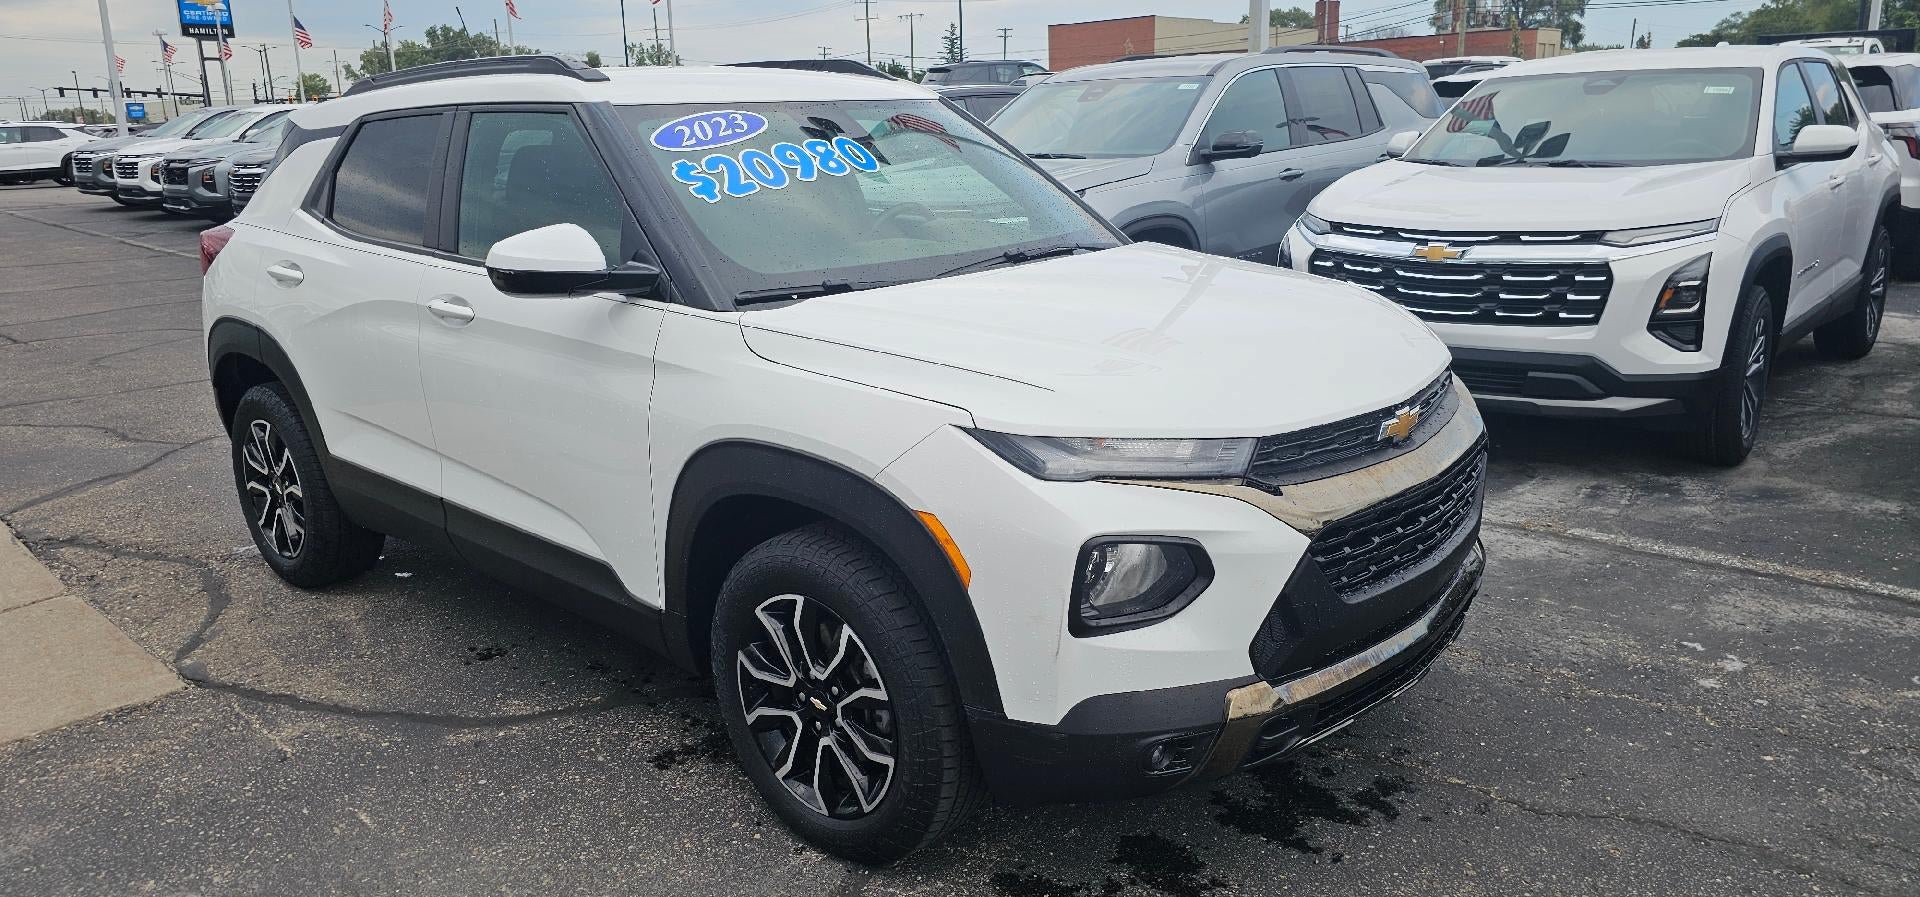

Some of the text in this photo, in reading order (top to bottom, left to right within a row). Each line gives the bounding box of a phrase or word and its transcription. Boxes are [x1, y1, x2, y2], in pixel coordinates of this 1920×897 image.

[189, 27, 229, 35] HAMILTON
[674, 114, 748, 147] 2023
[671, 136, 880, 203] $20980
